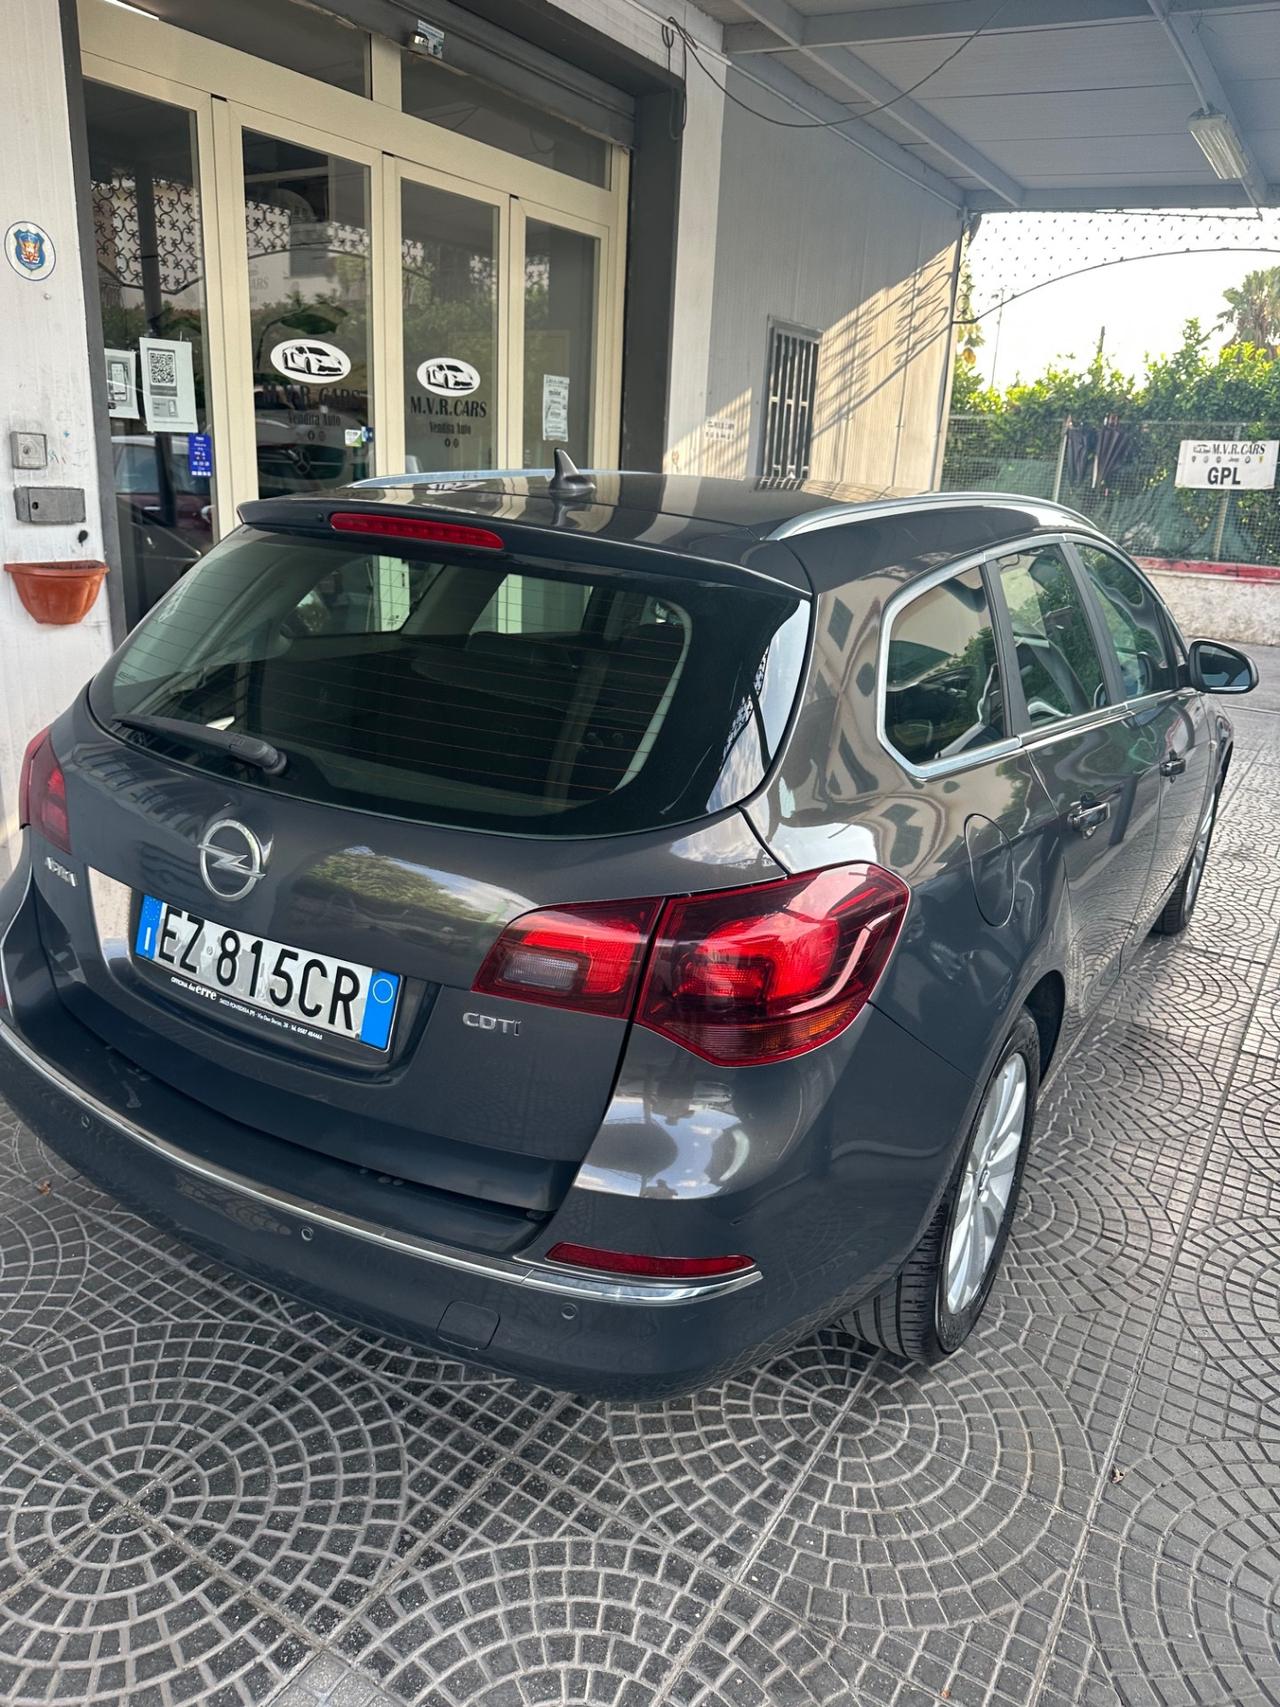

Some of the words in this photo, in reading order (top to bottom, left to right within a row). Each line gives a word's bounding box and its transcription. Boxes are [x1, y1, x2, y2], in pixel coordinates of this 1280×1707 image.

[1207, 466, 1242, 486] GPL
[158, 903, 206, 975] EZ
[216, 930, 361, 1032] 815CR
